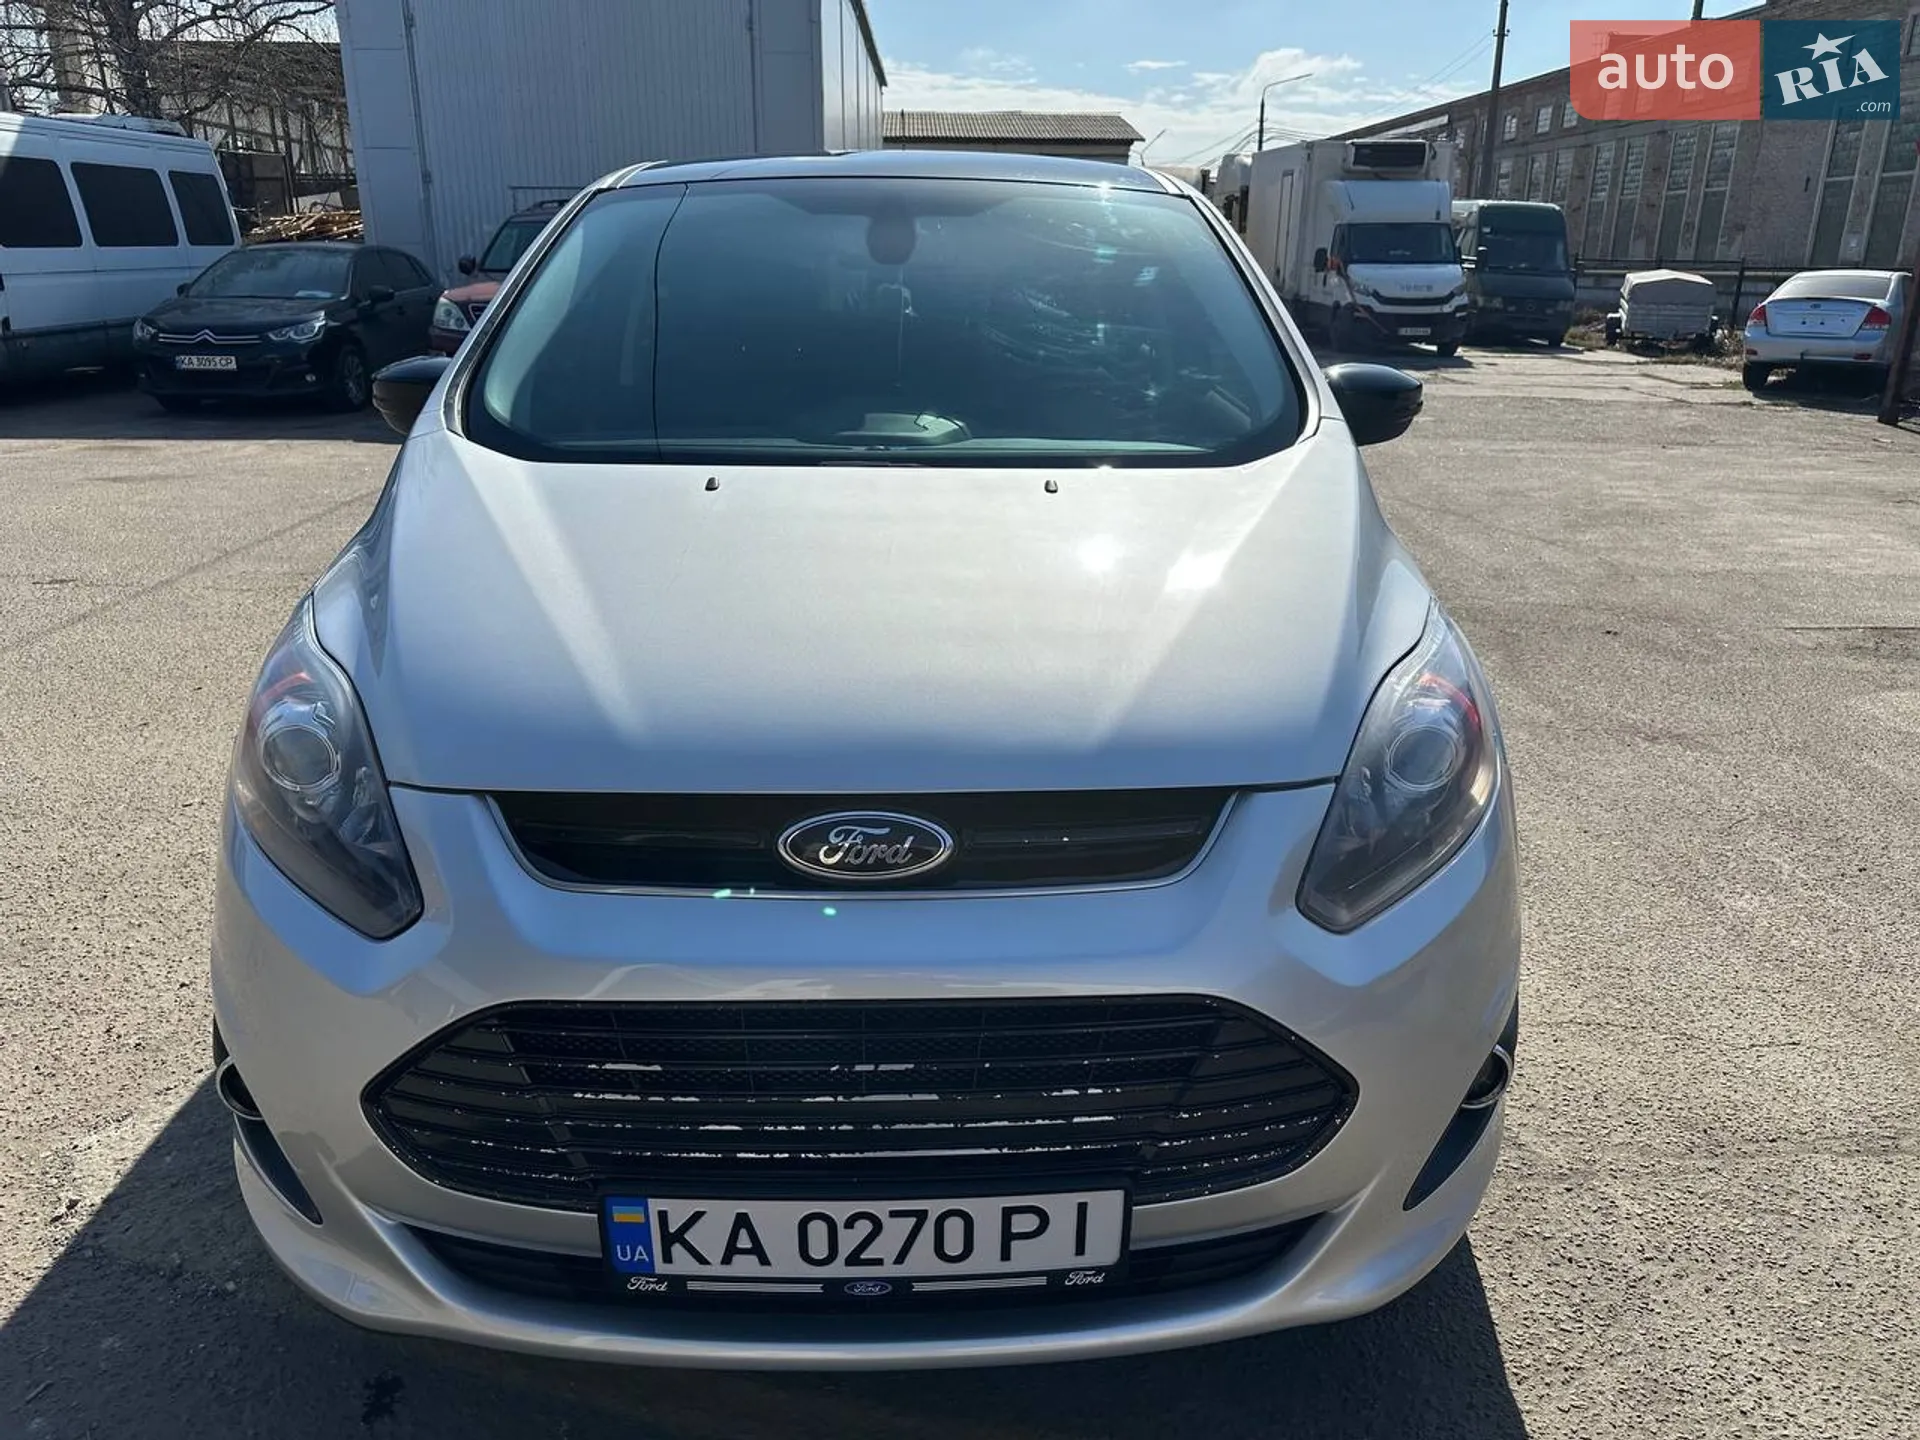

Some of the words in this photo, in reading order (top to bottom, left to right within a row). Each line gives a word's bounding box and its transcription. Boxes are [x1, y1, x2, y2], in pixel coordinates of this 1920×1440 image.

[818, 825, 915, 866] Ford
[656, 1209, 772, 1267] KA
[797, 1207, 975, 1268] 0270
[999, 1201, 1089, 1262] PI
[615, 1244, 649, 1262] UA
[626, 1276, 669, 1292] Ford
[1064, 1270, 1106, 1286] Ford
[852, 1282, 882, 1294] Ford
